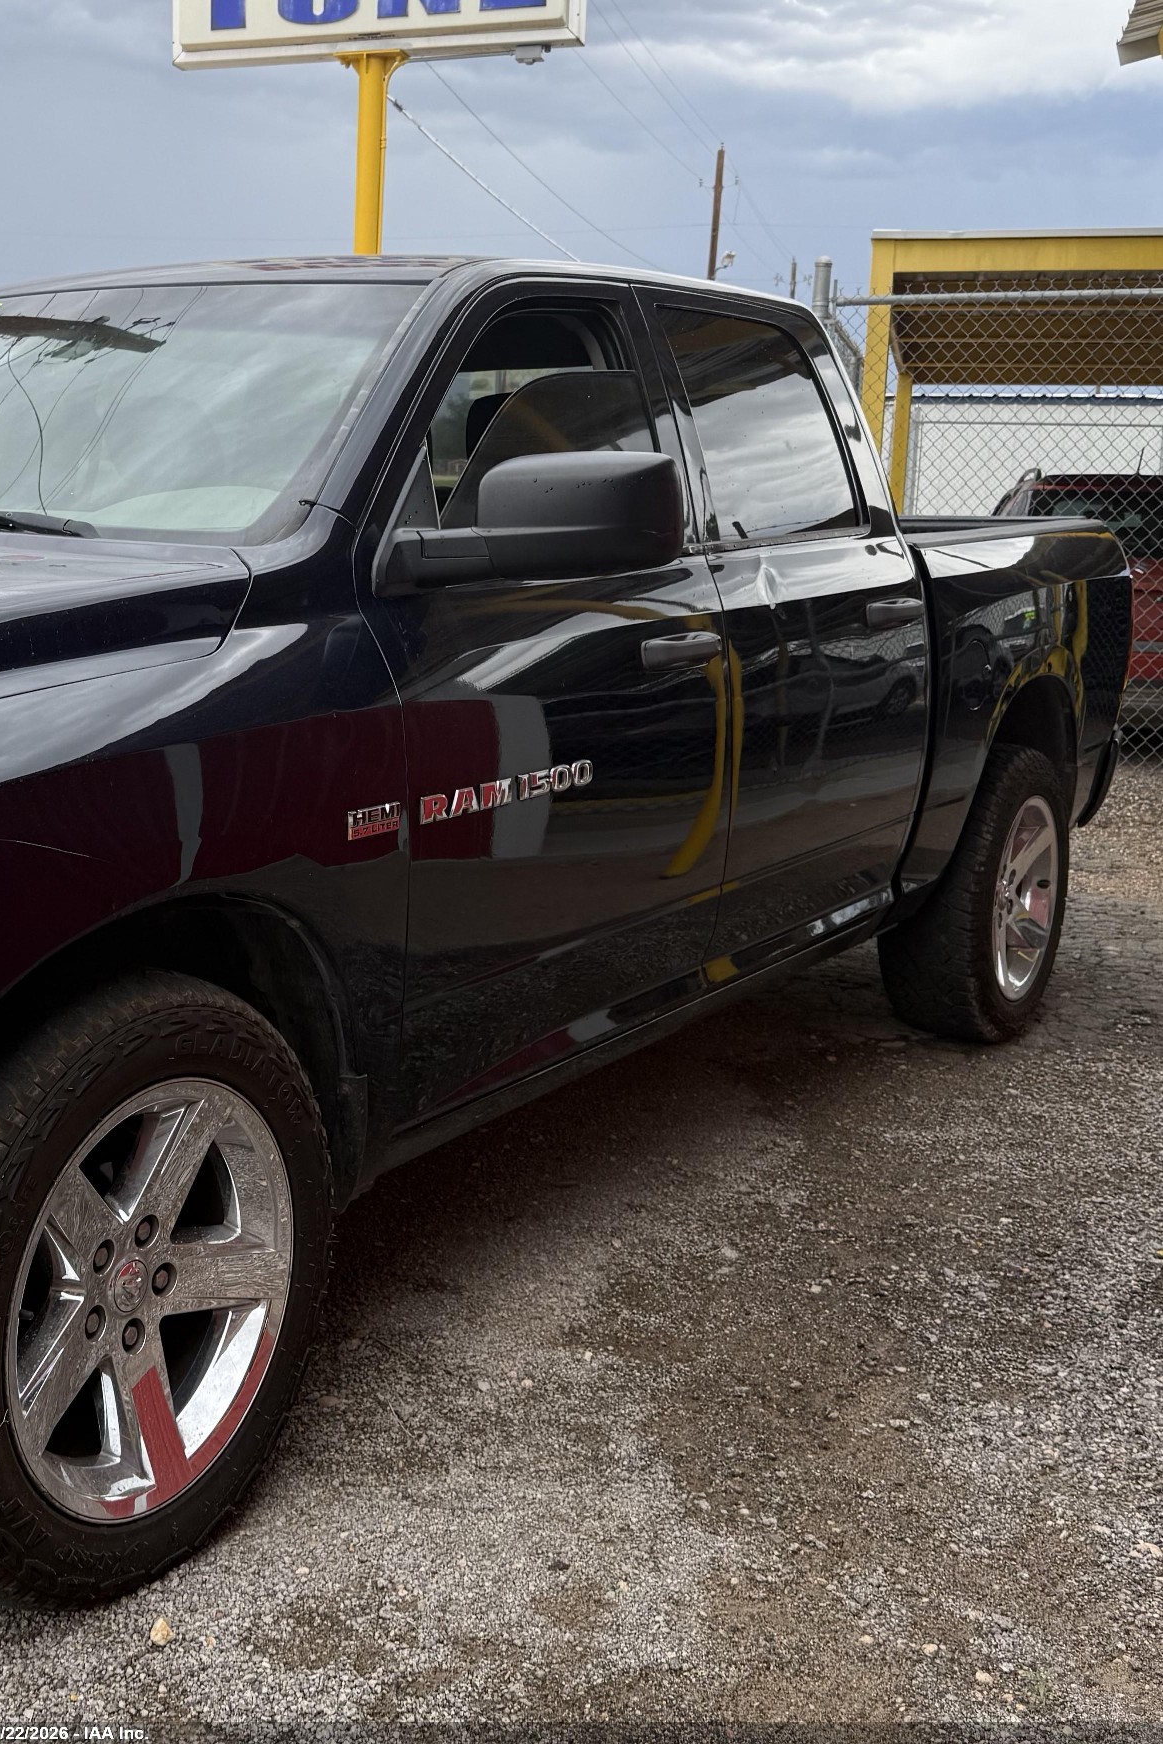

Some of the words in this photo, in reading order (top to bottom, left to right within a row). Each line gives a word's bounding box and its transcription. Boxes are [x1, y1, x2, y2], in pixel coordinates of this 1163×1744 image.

[420, 777, 513, 825] RAM
[517, 759, 594, 801] 1500
[348, 801, 401, 829] HEMI
[351, 825, 369, 839] 5.7
[371, 819, 401, 834] LITER
